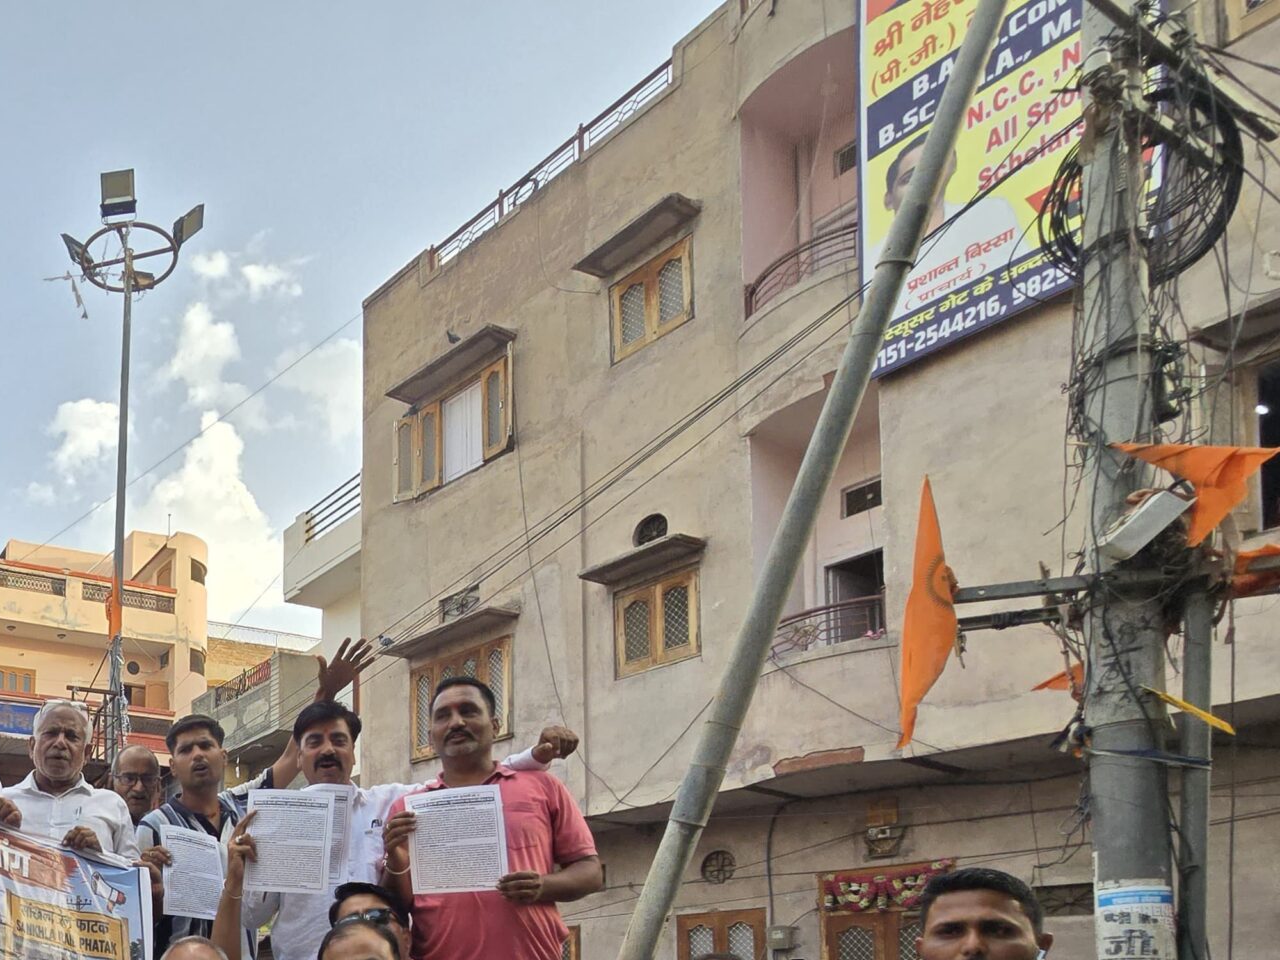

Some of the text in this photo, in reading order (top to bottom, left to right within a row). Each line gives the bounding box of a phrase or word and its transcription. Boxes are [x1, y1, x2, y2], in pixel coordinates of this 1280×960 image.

[985, 115, 1018, 154] All
[938, 289, 970, 313] गेट
[972, 275, 995, 296] के
[76, 919, 110, 935] फाटक
[80, 937, 117, 956] PHATAK
